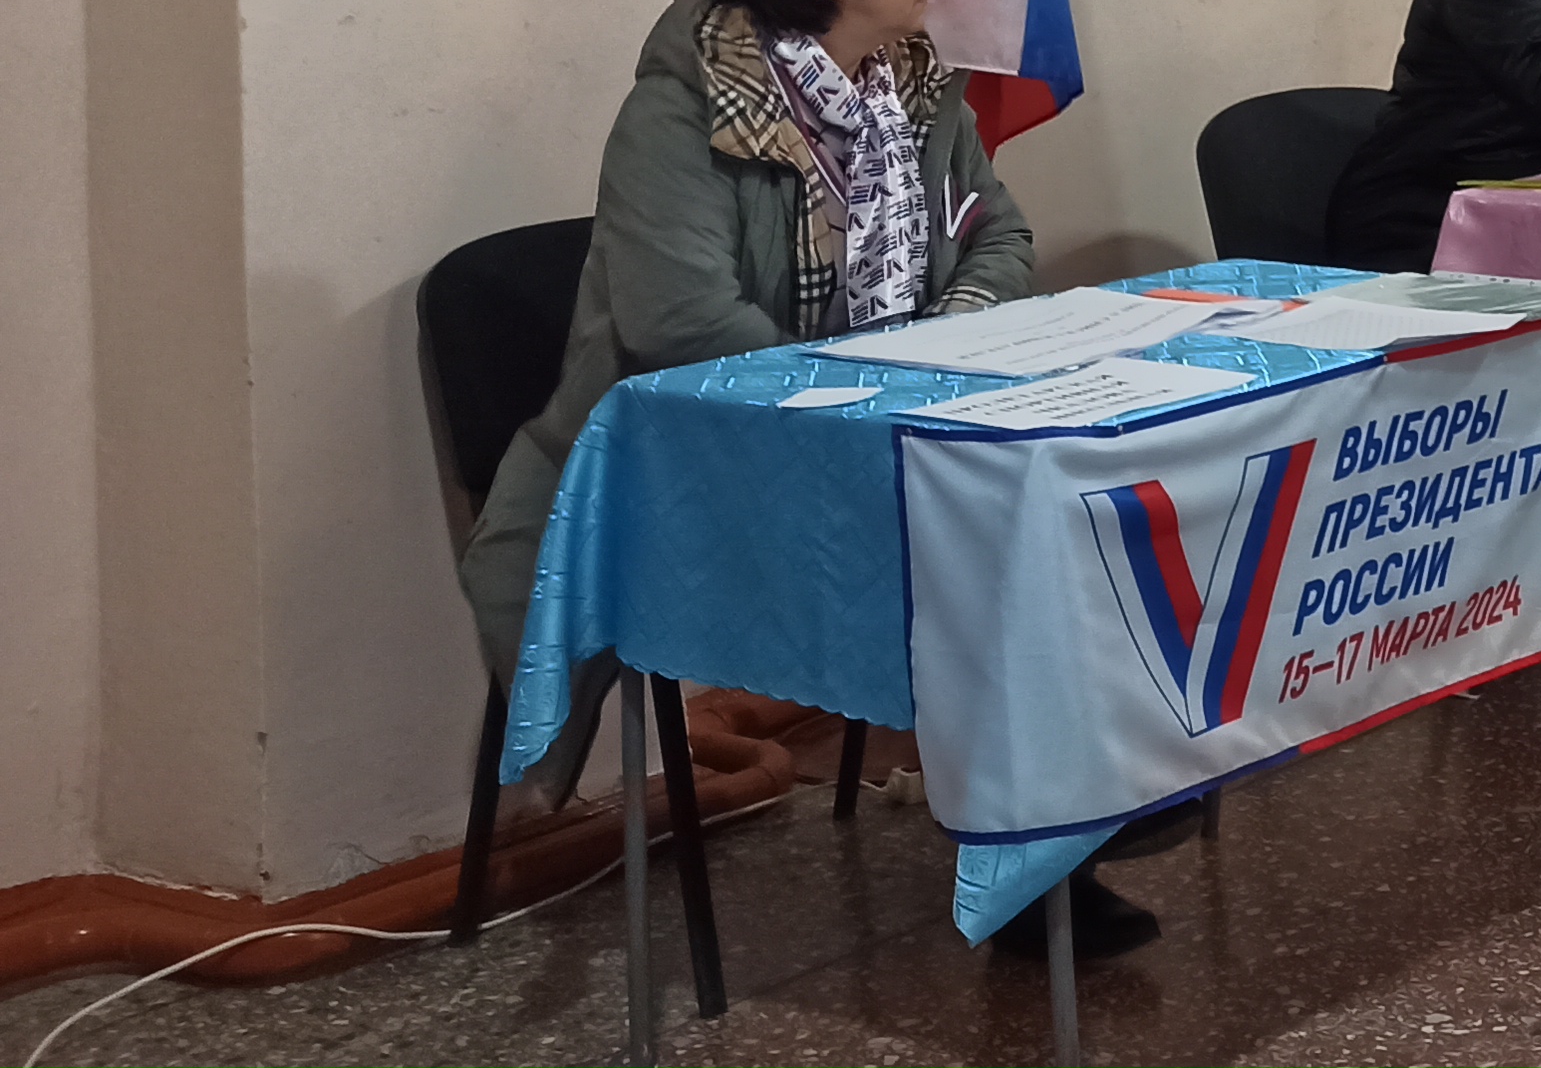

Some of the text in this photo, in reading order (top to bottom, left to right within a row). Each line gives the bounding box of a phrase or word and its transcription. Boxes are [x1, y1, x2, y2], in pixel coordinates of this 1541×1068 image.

[1333, 389, 1508, 481] ВЫБОРЫ
[1292, 536, 1455, 637] РОССИИ
[1367, 601, 1457, 672] МАРТА
[1455, 575, 1523, 639] 2024
